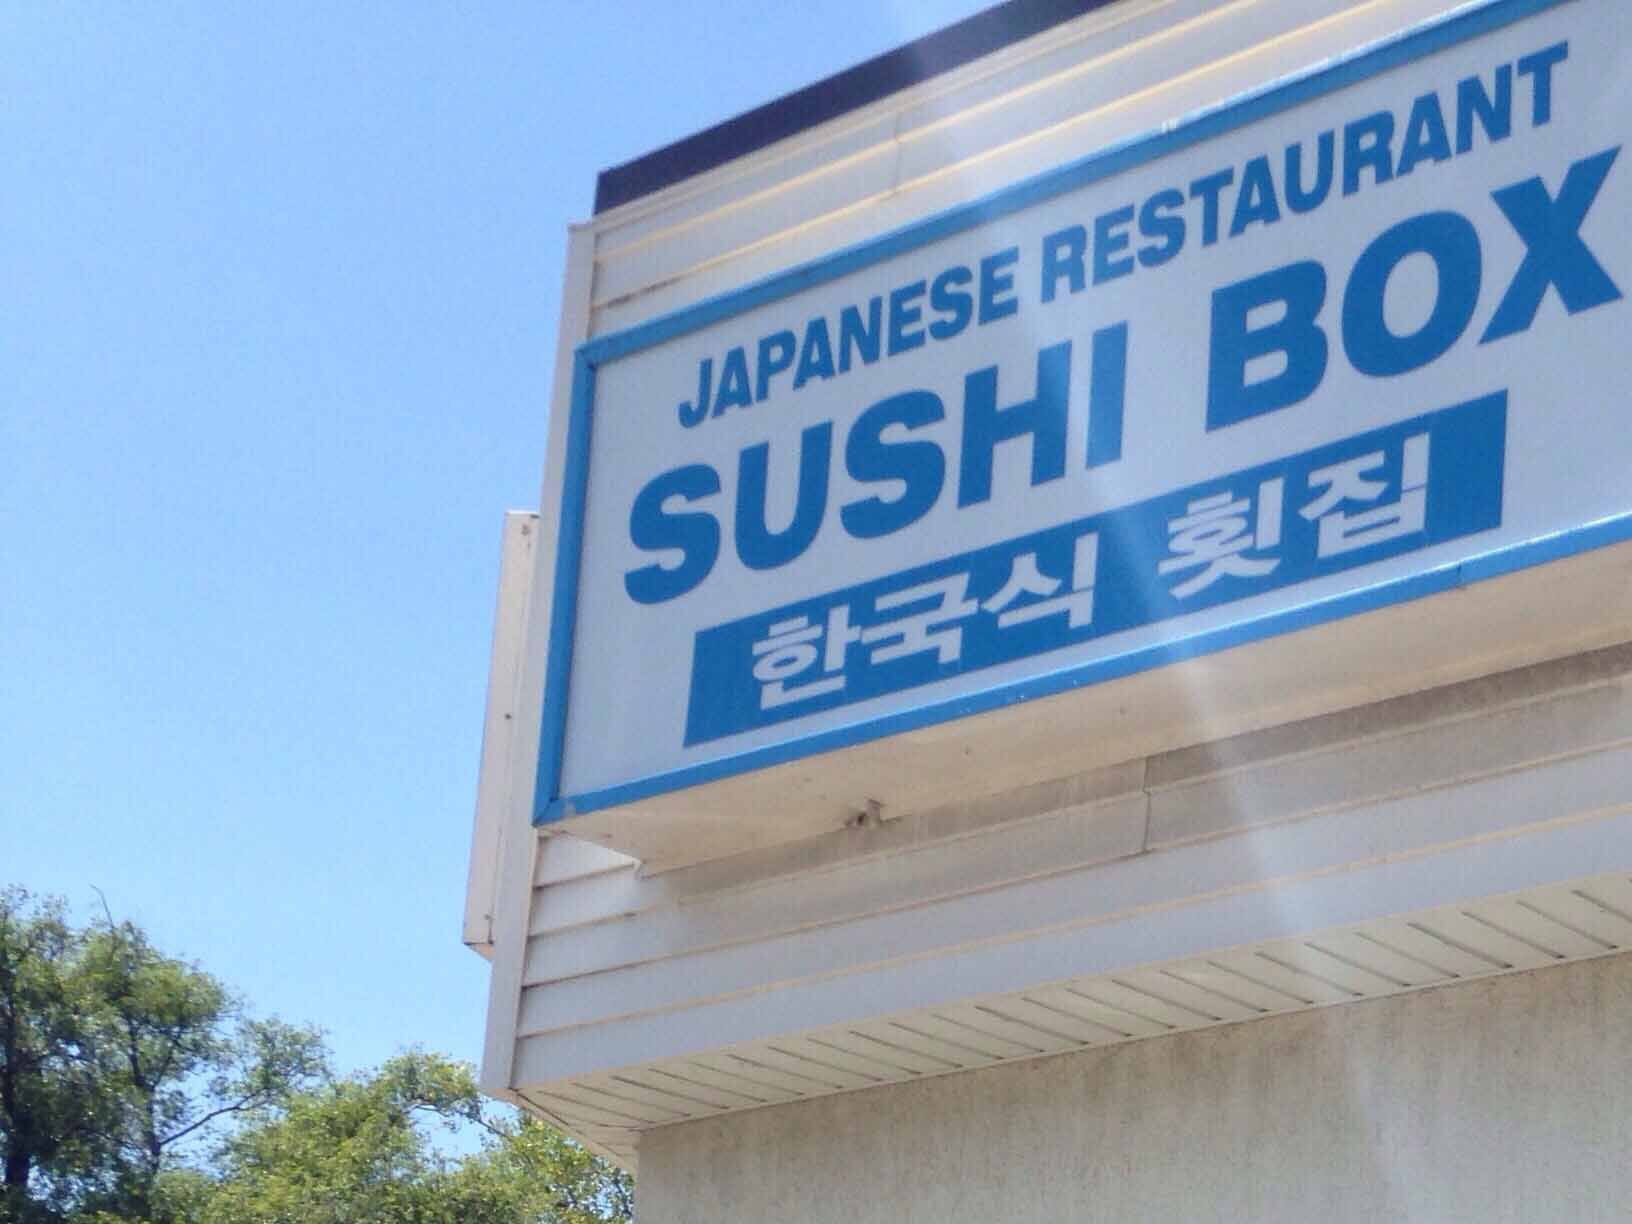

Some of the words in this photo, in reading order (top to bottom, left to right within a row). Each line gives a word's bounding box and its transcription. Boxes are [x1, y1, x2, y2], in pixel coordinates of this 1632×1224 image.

[623, 323, 1129, 606] SUSHI
[1205, 145, 1622, 430] BOX
[678, 254, 1020, 429] JAPANESE
[1038, 40, 1569, 306] RESTAURANT
[751, 532, 1099, 710] 한국식
[1156, 432, 1430, 598] 횟집
